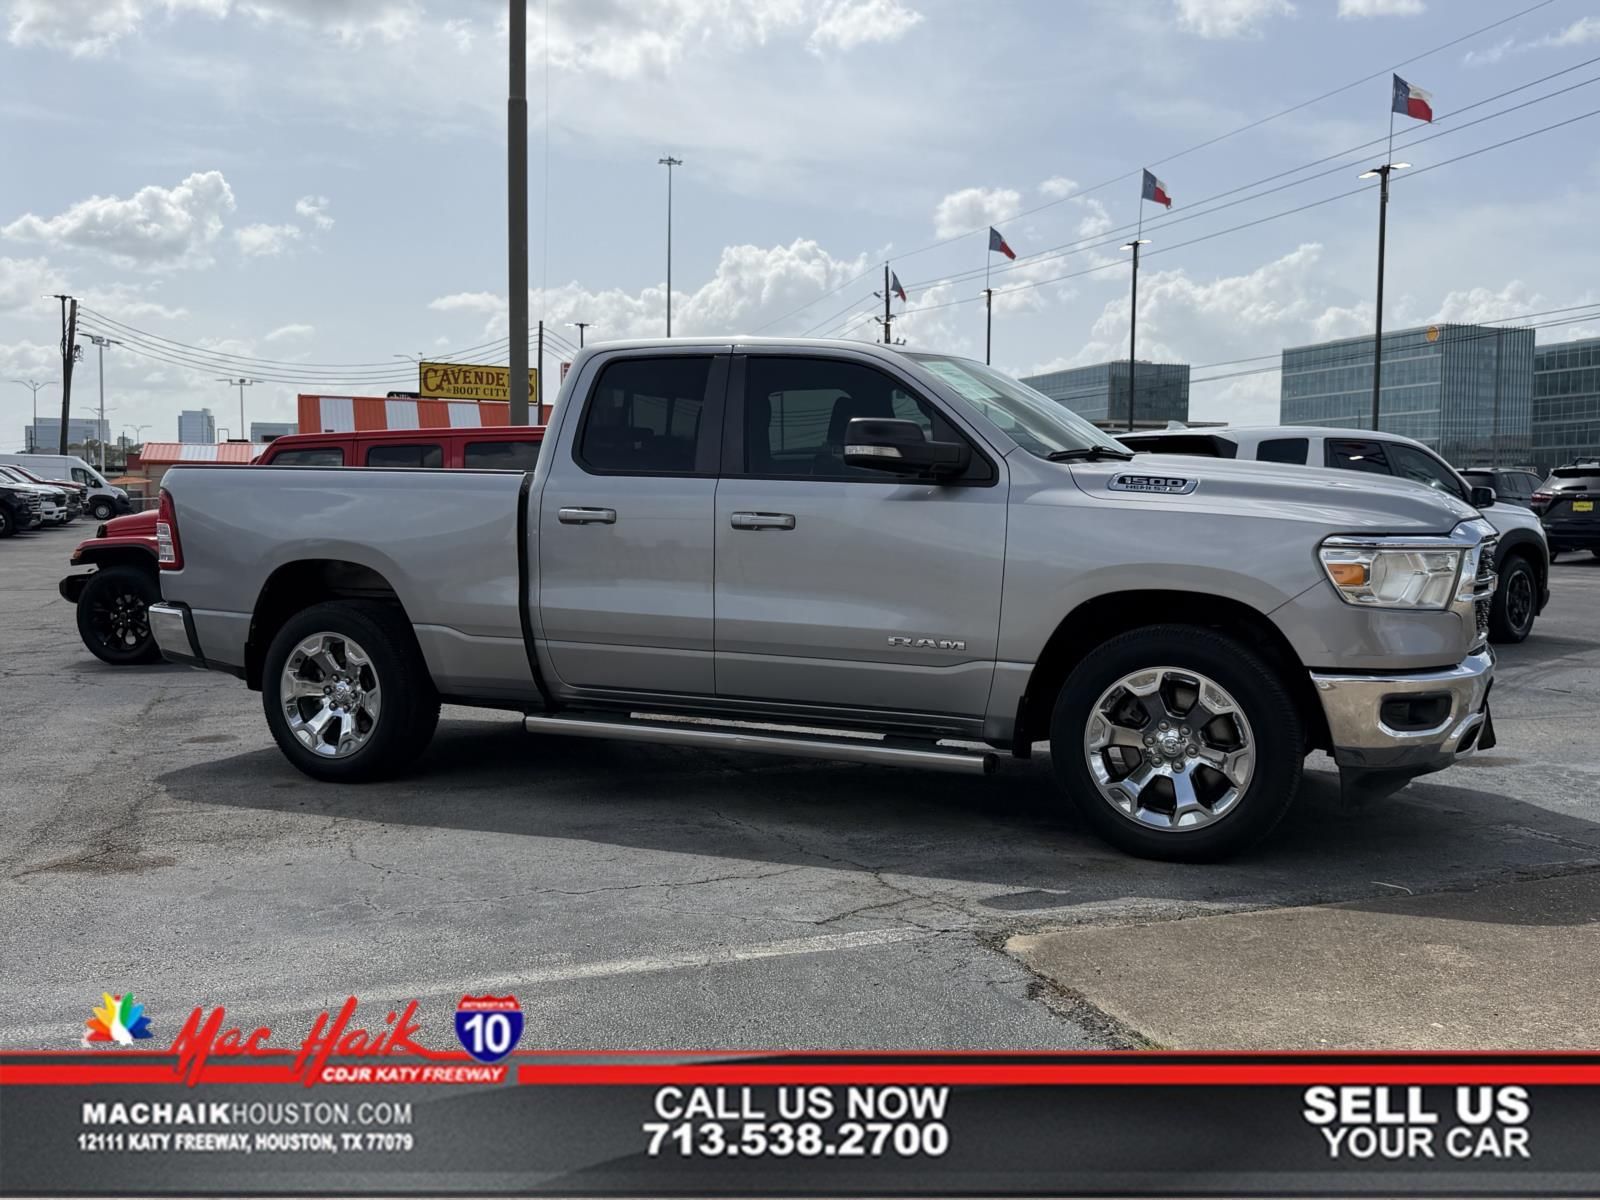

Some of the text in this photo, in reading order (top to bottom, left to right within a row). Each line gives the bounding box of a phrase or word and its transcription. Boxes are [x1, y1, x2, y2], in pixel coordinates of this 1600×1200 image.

[453, 386, 508, 397] BOOT CITY
[1124, 477, 1184, 486] 1500
[888, 636, 965, 650] RAM
